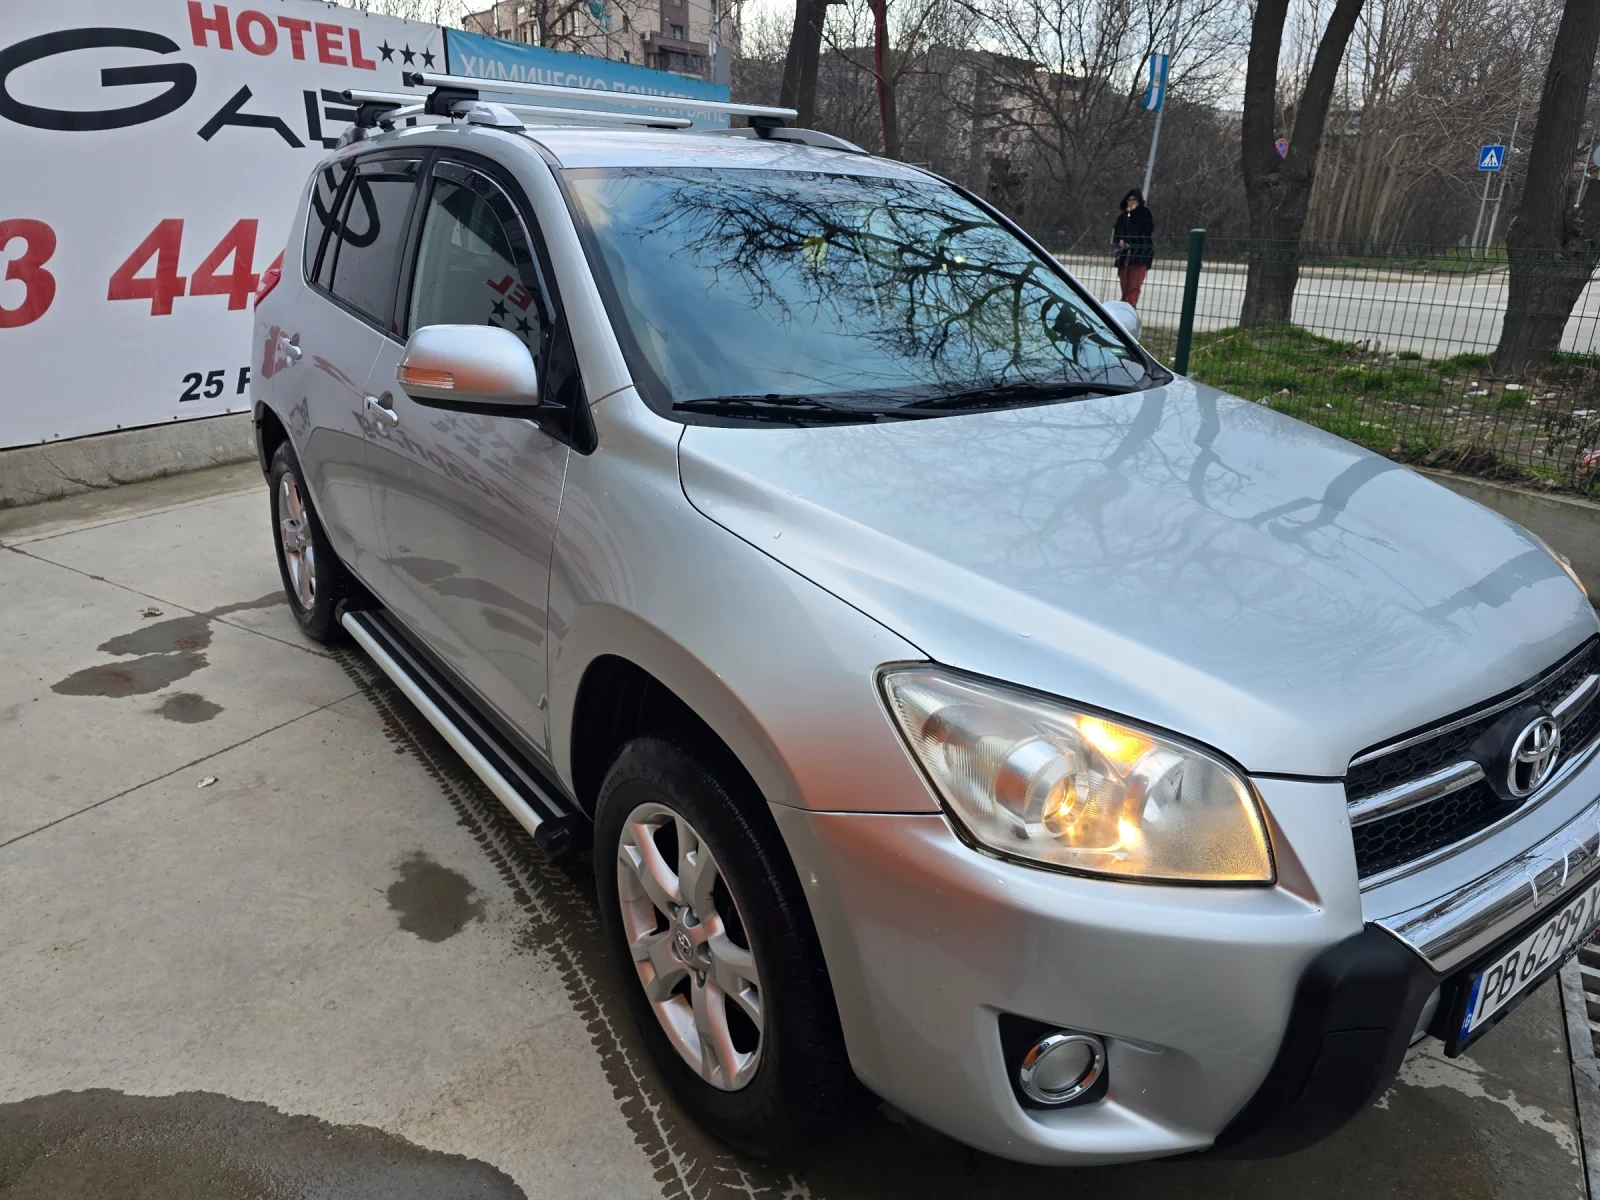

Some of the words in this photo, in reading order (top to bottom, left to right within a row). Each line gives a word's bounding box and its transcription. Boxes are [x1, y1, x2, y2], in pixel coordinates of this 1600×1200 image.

[187, 0, 377, 71] HOTEL
[107, 218, 286, 317] 44
[179, 370, 225, 402] 25
